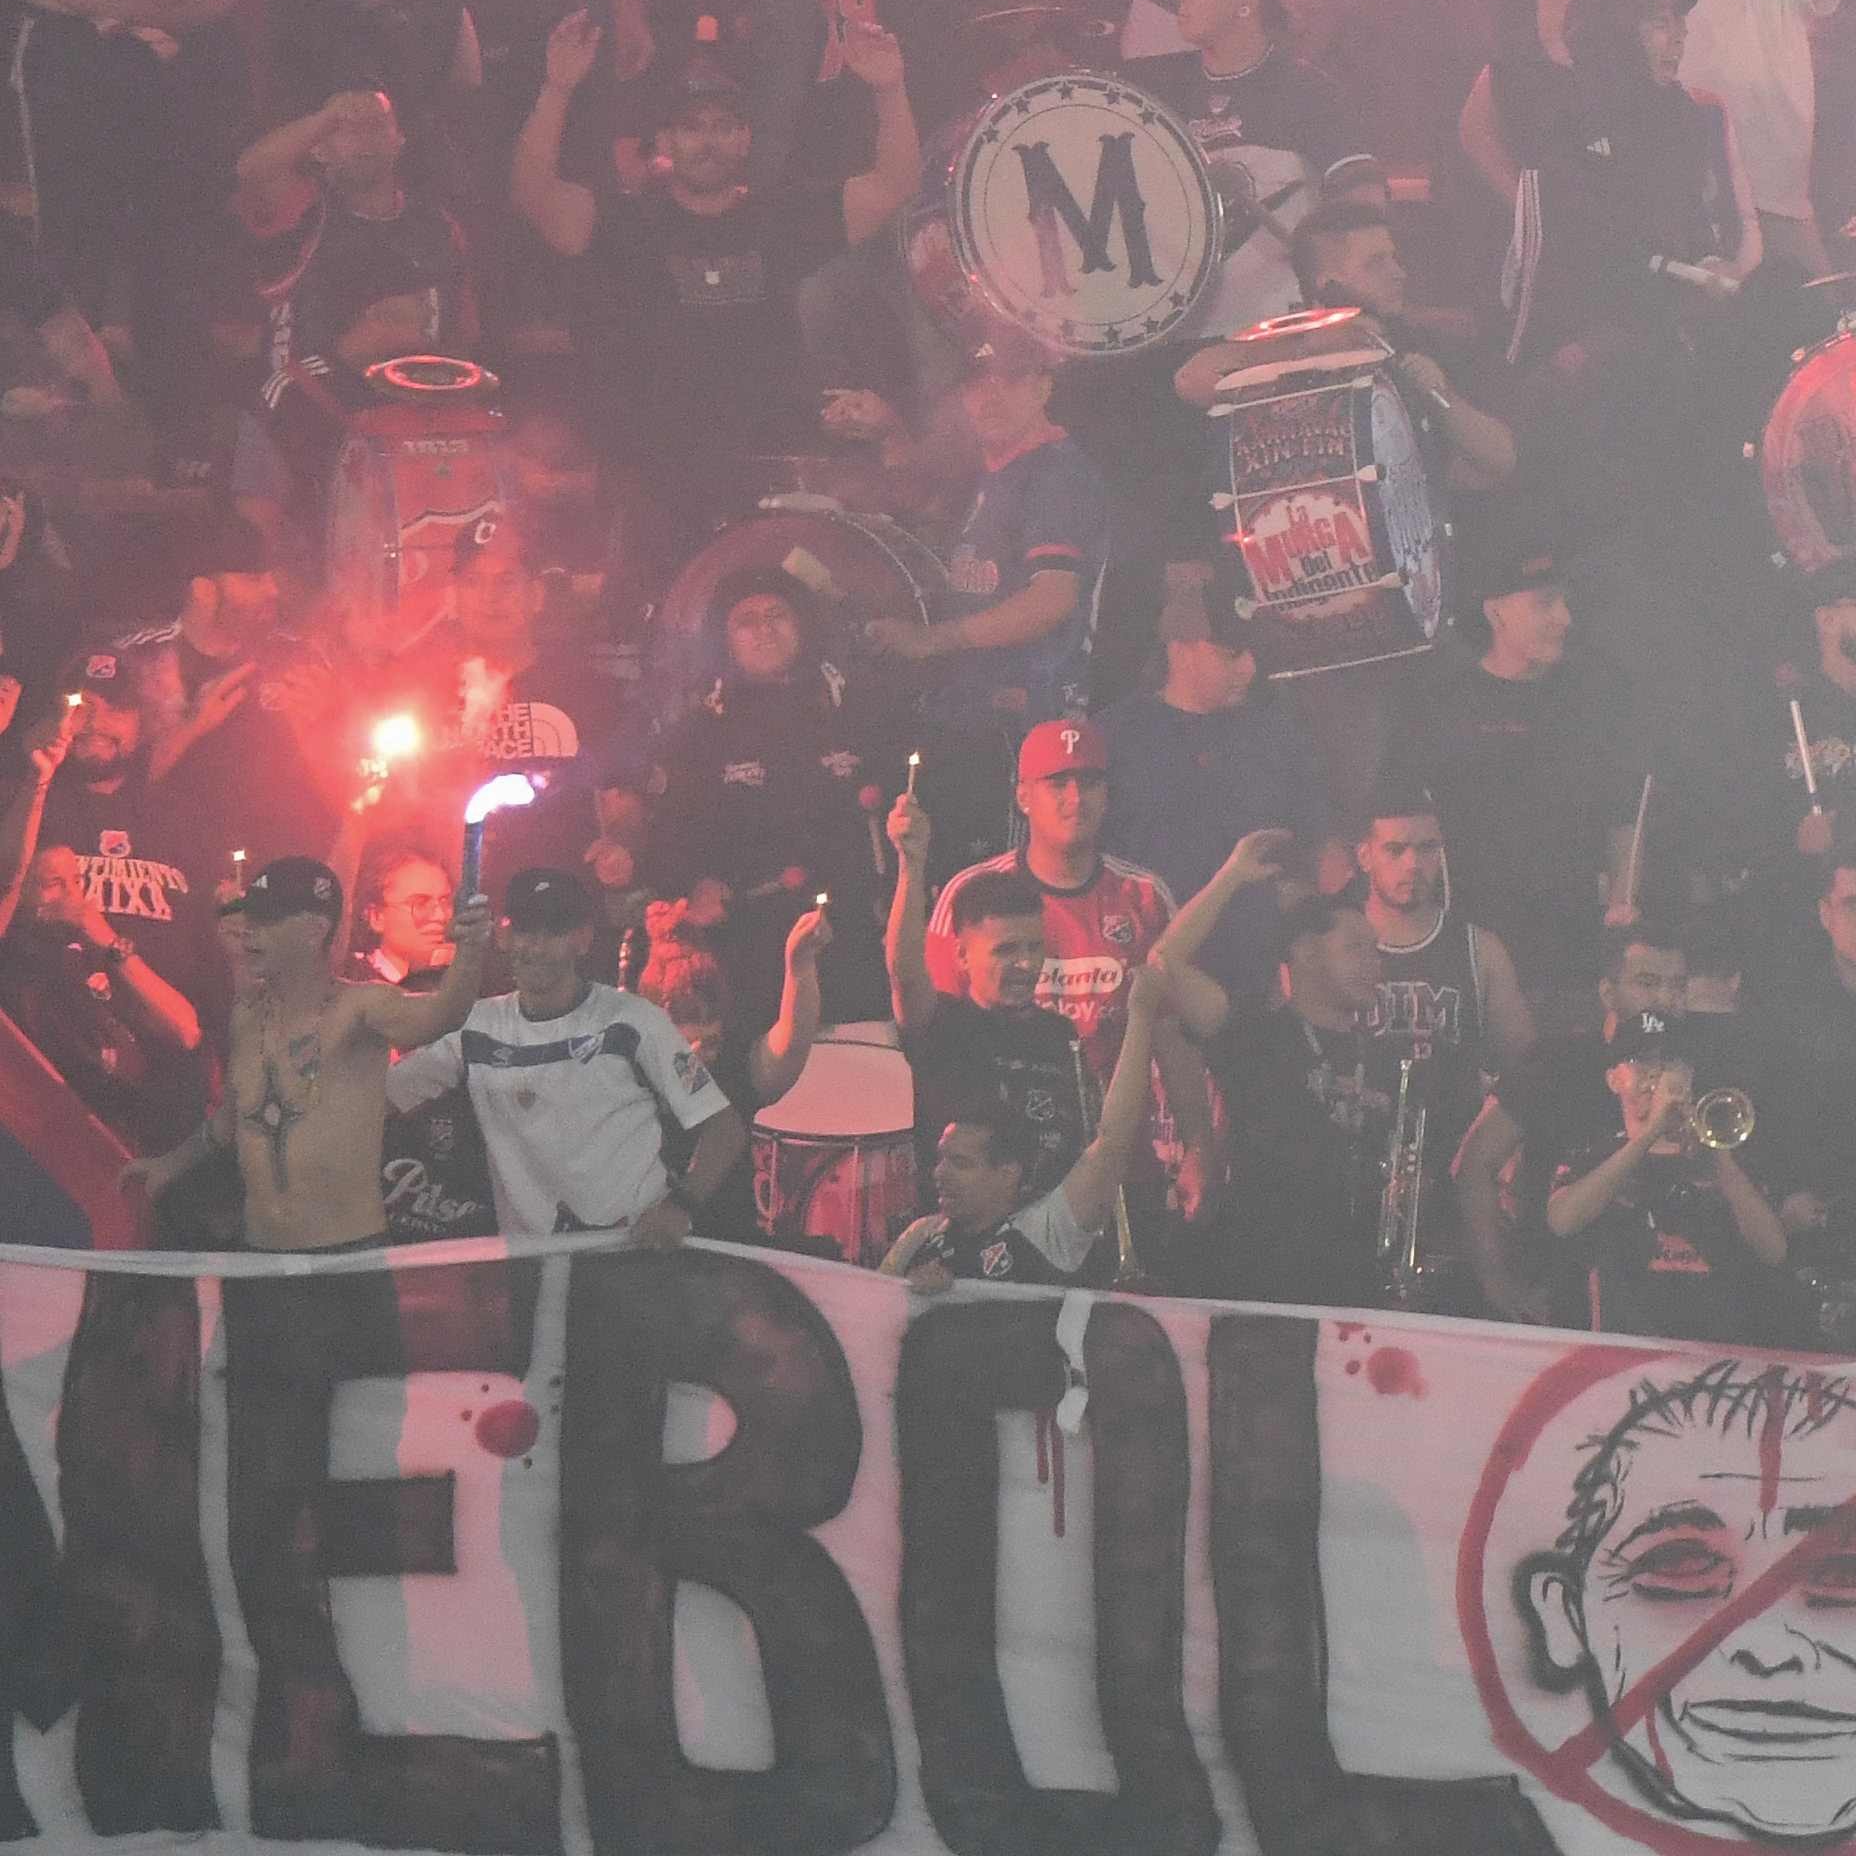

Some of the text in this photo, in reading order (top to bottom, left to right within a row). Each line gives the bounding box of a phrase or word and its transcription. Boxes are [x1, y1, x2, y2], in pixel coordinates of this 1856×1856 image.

[1011, 130, 1165, 300] M
[1244, 510, 1371, 587] MURGA
[1060, 729, 1080, 755] P
[1036, 966, 1117, 988] olanta
